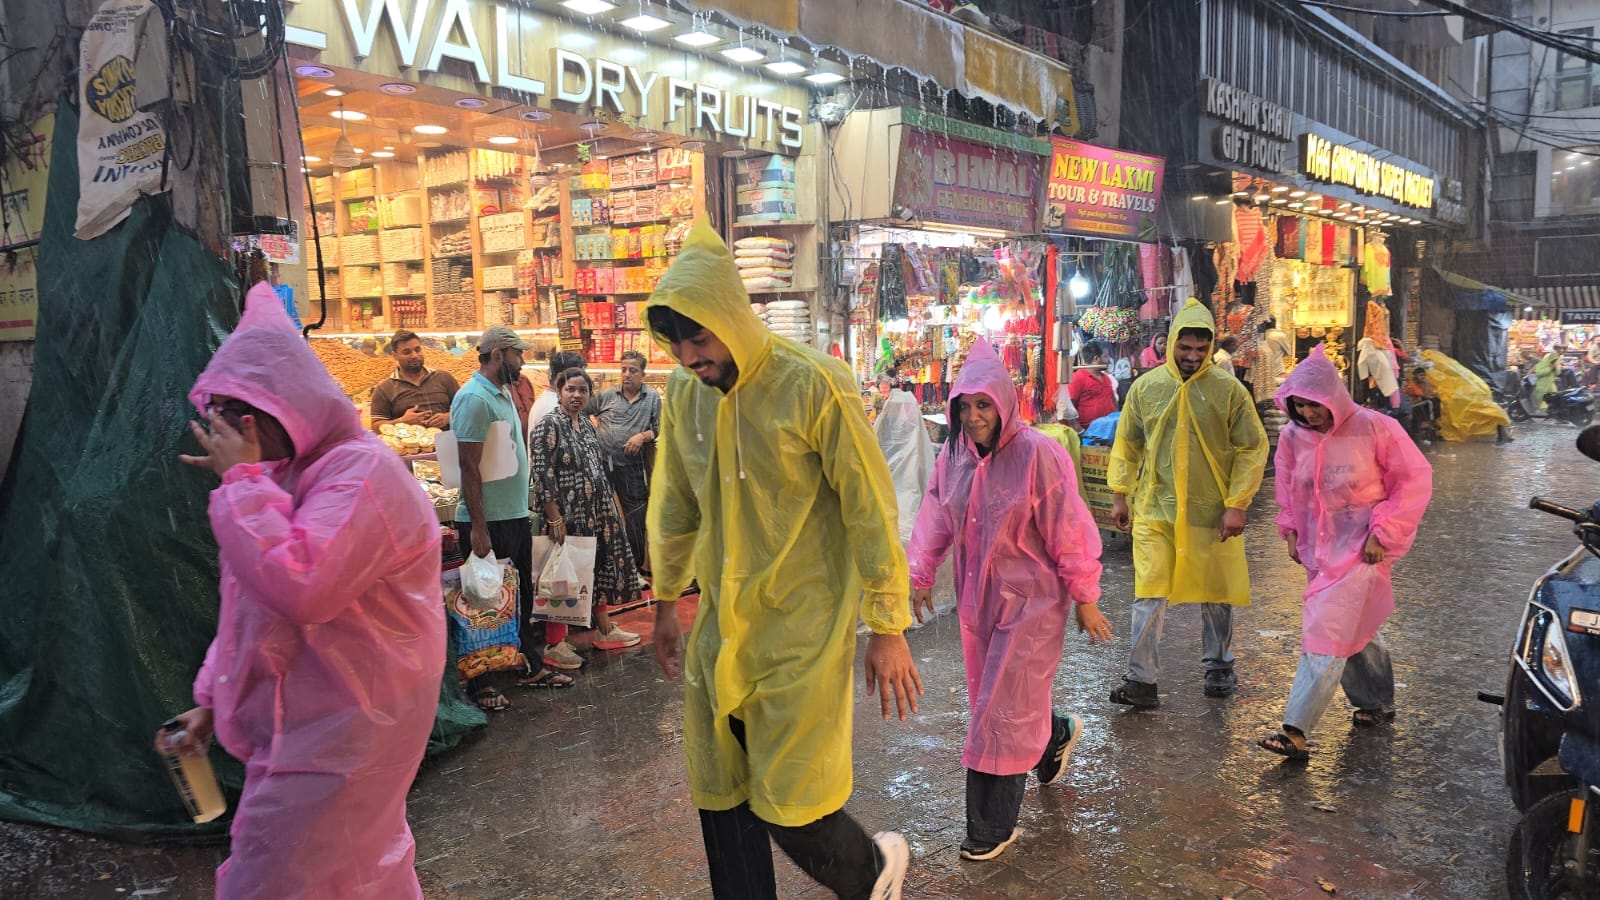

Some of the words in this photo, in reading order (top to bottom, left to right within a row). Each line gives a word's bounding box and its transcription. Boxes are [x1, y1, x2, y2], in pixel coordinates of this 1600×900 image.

[285, 0, 545, 97] WAL
[556, 48, 657, 117] DRY
[667, 76, 803, 149] FRUITS
[1207, 77, 1262, 130] KASHMIR
[1262, 101, 1296, 141] SHAWL
[1222, 125, 1250, 164] GIFT
[1250, 134, 1287, 173] HOUSE
[1054, 152, 1099, 184] NEW
[1100, 161, 1156, 193] LAXMI
[936, 189, 988, 214] GENERAL
[994, 198, 1029, 218] STORE
[1048, 182, 1086, 204] TOUR
[1088, 188, 1100, 205] &
[1101, 190, 1156, 213] TRAVELS
